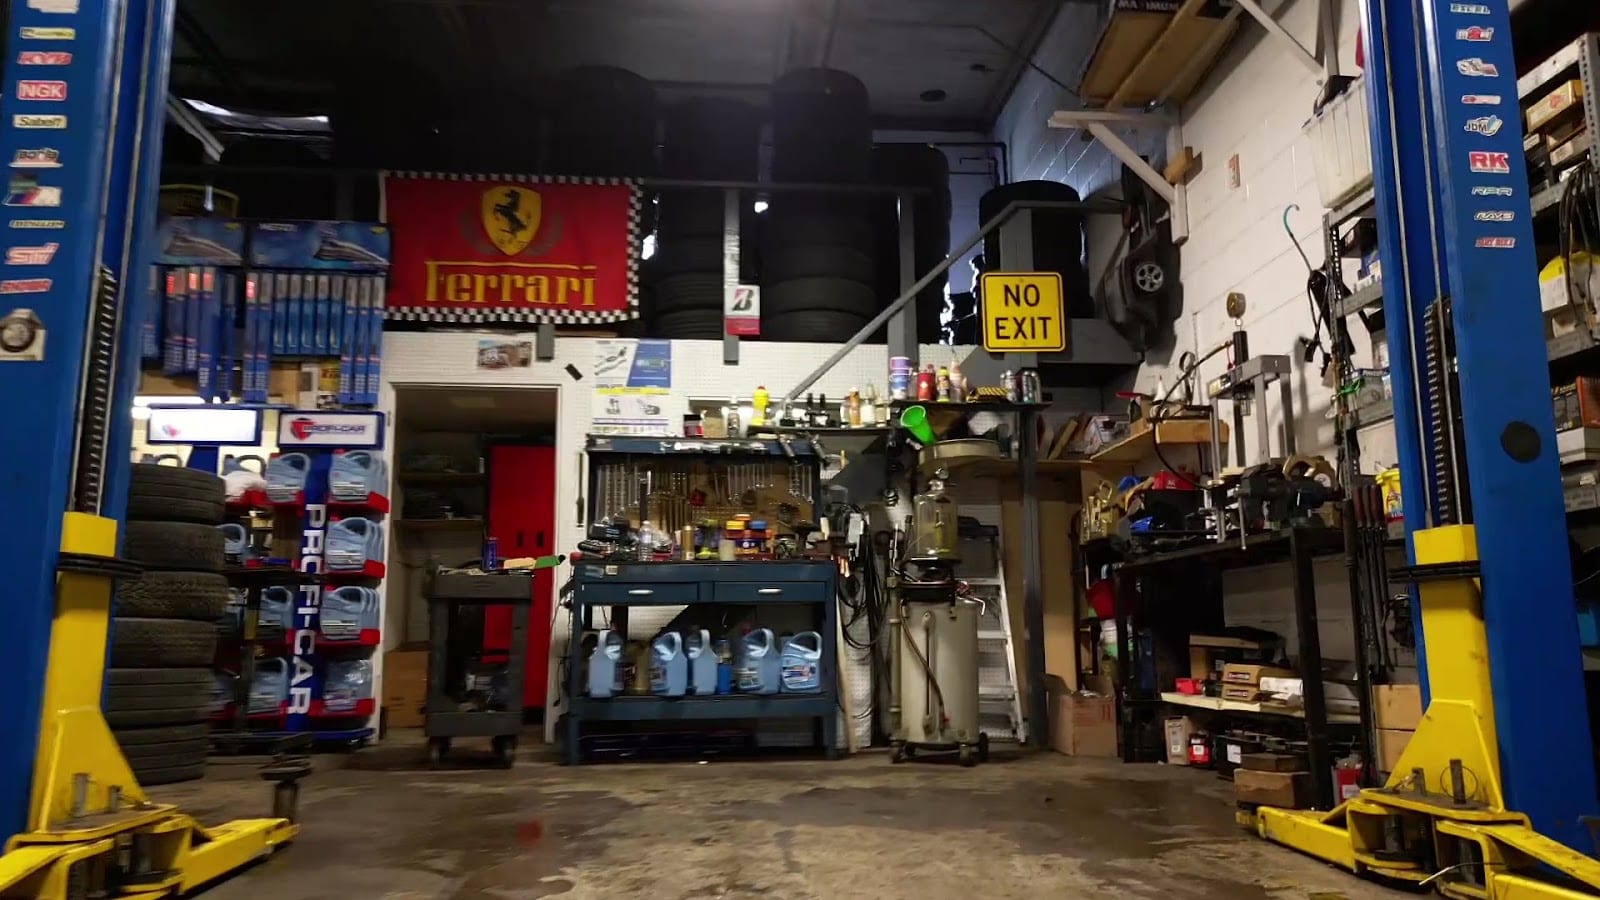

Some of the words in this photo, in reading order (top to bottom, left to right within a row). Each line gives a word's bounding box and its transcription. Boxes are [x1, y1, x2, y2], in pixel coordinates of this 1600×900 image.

[21, 84, 63, 98] NGK
[1470, 153, 1507, 169] RK
[424, 261, 598, 306] Ferrari
[1003, 284, 1040, 307] NO
[995, 316, 1052, 340] EXIT
